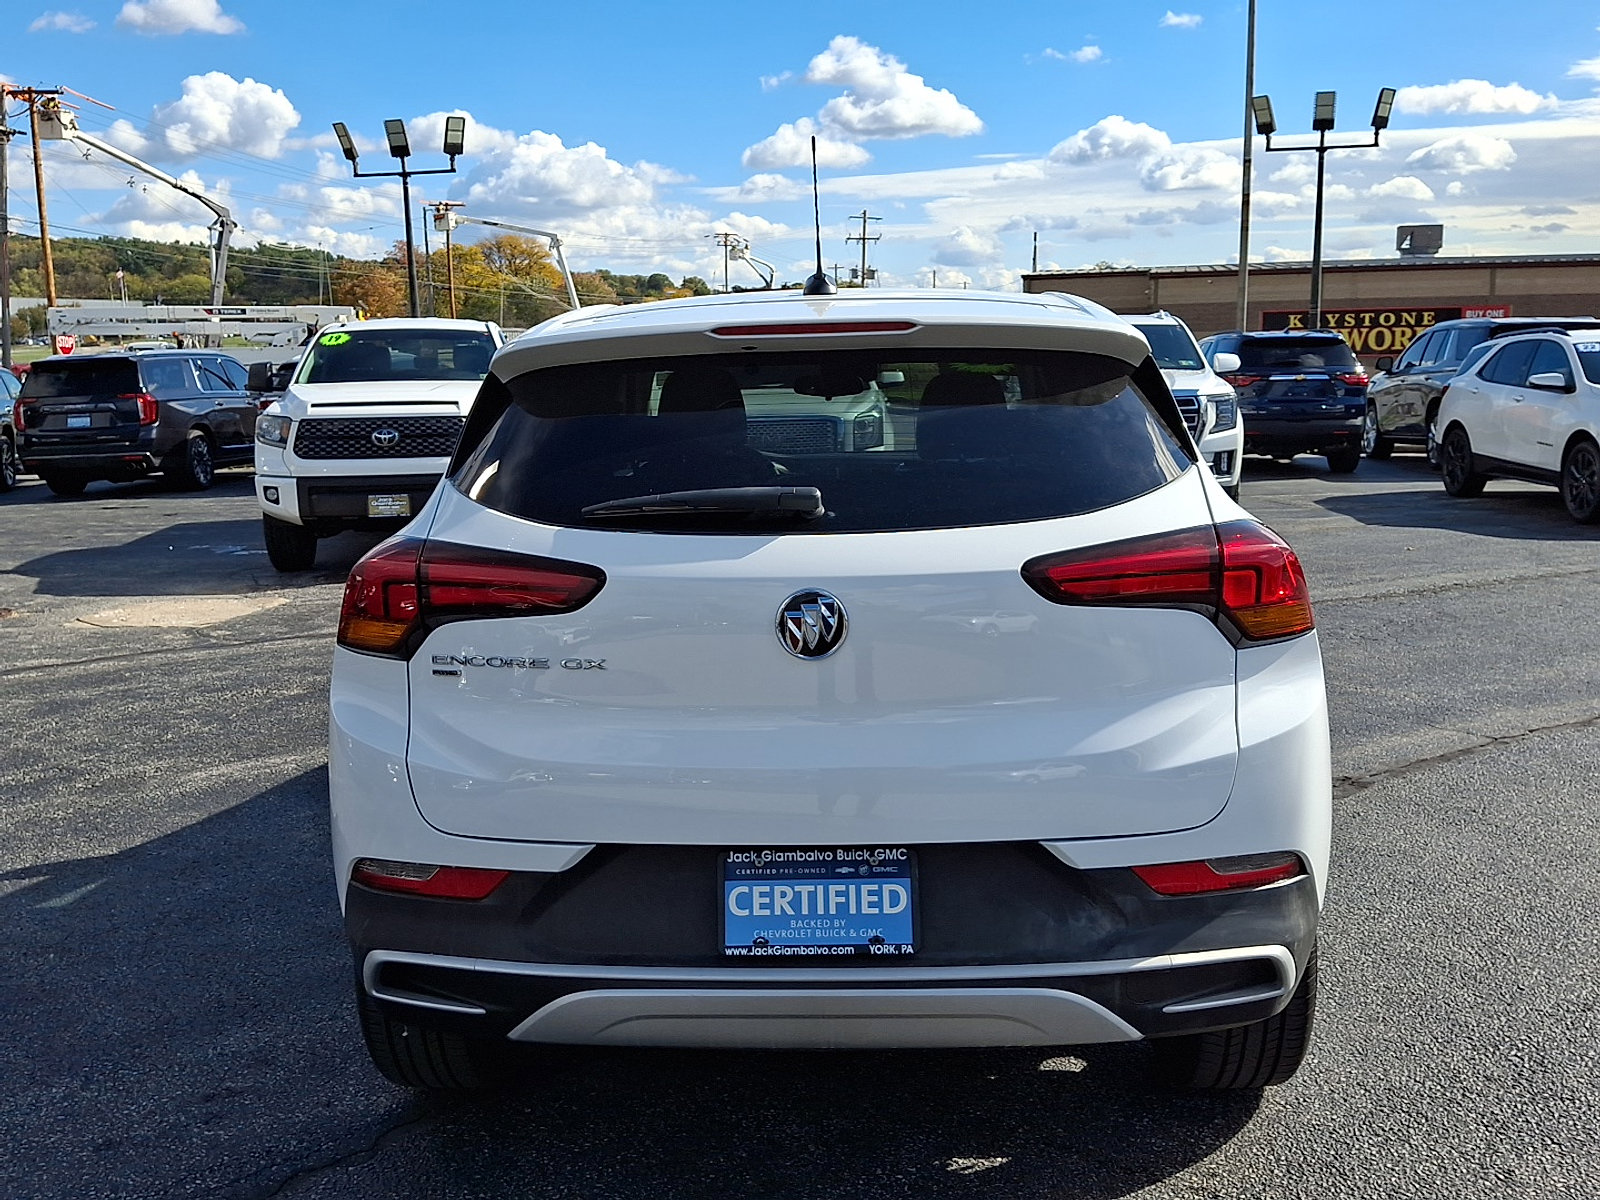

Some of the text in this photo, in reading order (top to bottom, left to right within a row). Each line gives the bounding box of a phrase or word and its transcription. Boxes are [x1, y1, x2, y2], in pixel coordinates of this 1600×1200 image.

[1465, 309, 1505, 318] BUY ONE
[1288, 311, 1436, 328] KYSTONE
[57, 335, 74, 348] STOP
[431, 654, 608, 671] ENCORE GX
[726, 848, 908, 863] Jack Giambalvo Buick GMC
[735, 867, 826, 875] CERTIFIED PRE-OWNED
[728, 883, 908, 916] CERTIFIED
[790, 918, 847, 928] BACKED BY
[753, 928, 884, 938] CHEVROLET BUICK & GMC
[725, 945, 855, 956] www.JackGiambalvo.com
[901, 944, 914, 954] PA
